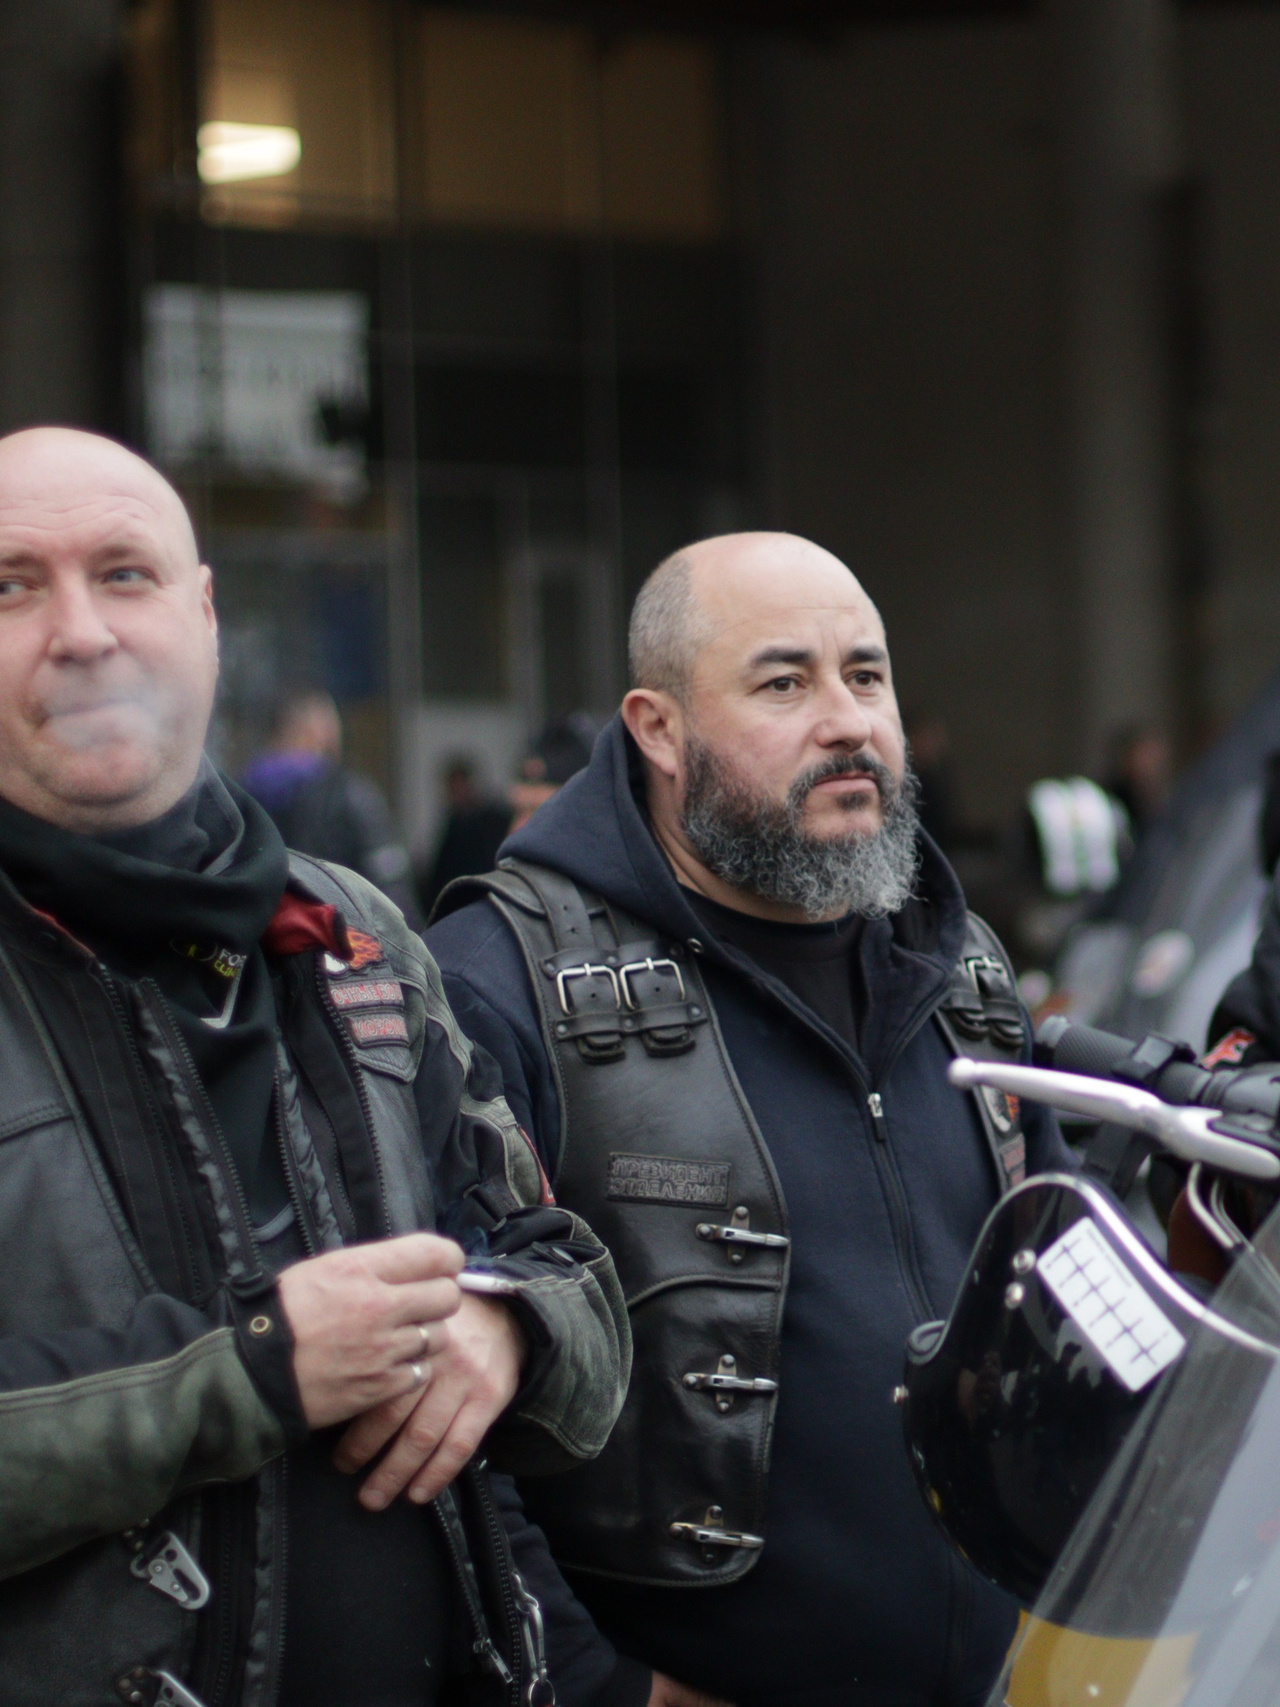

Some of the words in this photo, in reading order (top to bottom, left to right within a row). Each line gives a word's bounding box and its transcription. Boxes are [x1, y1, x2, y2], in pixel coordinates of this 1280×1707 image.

[330, 985, 381, 1005] ОЧНЫЕ
[612, 1158, 729, 1184] ПРЕЗИДЕНТ
[608, 1178, 726, 1203] ОТДЕЛЕНИЯ
